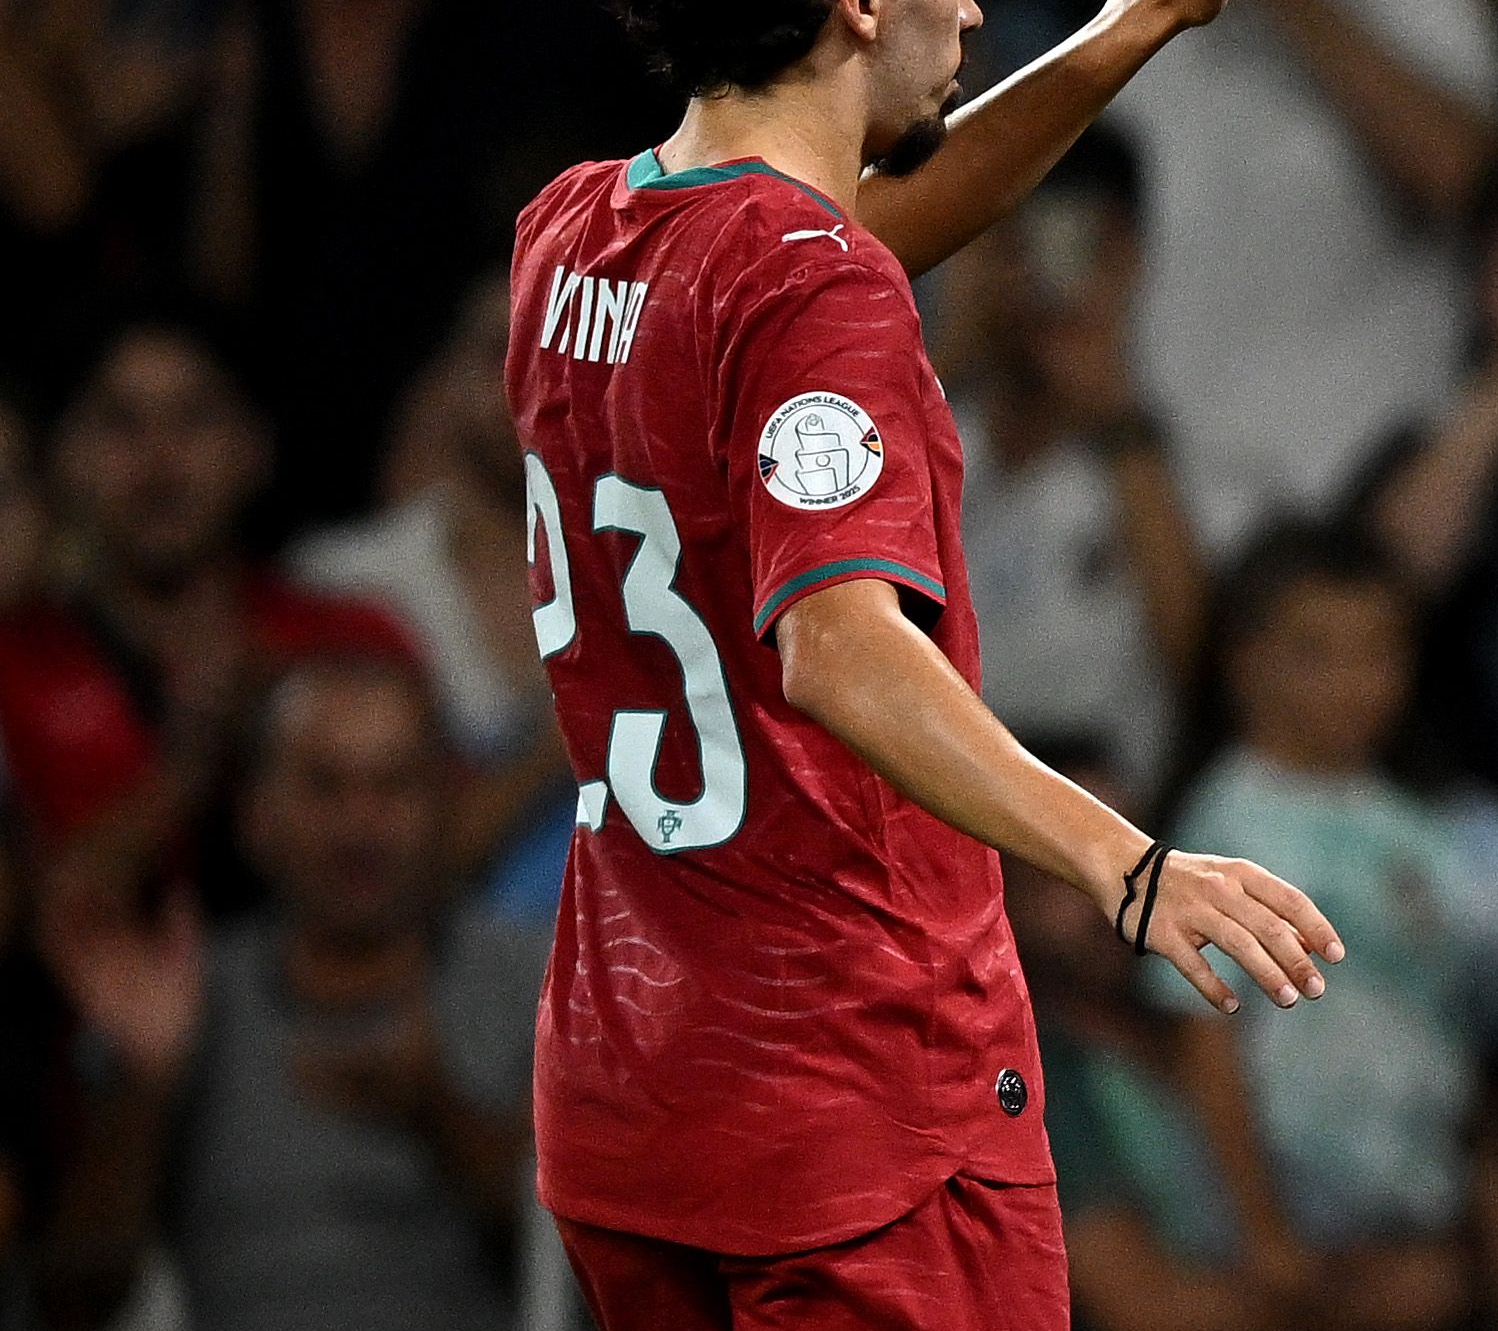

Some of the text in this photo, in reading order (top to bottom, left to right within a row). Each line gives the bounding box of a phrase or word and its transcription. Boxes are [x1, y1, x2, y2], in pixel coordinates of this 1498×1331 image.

[765, 395, 861, 439] UEFA NATIONS LEAGUE
[799, 495, 838, 505] WINNER
